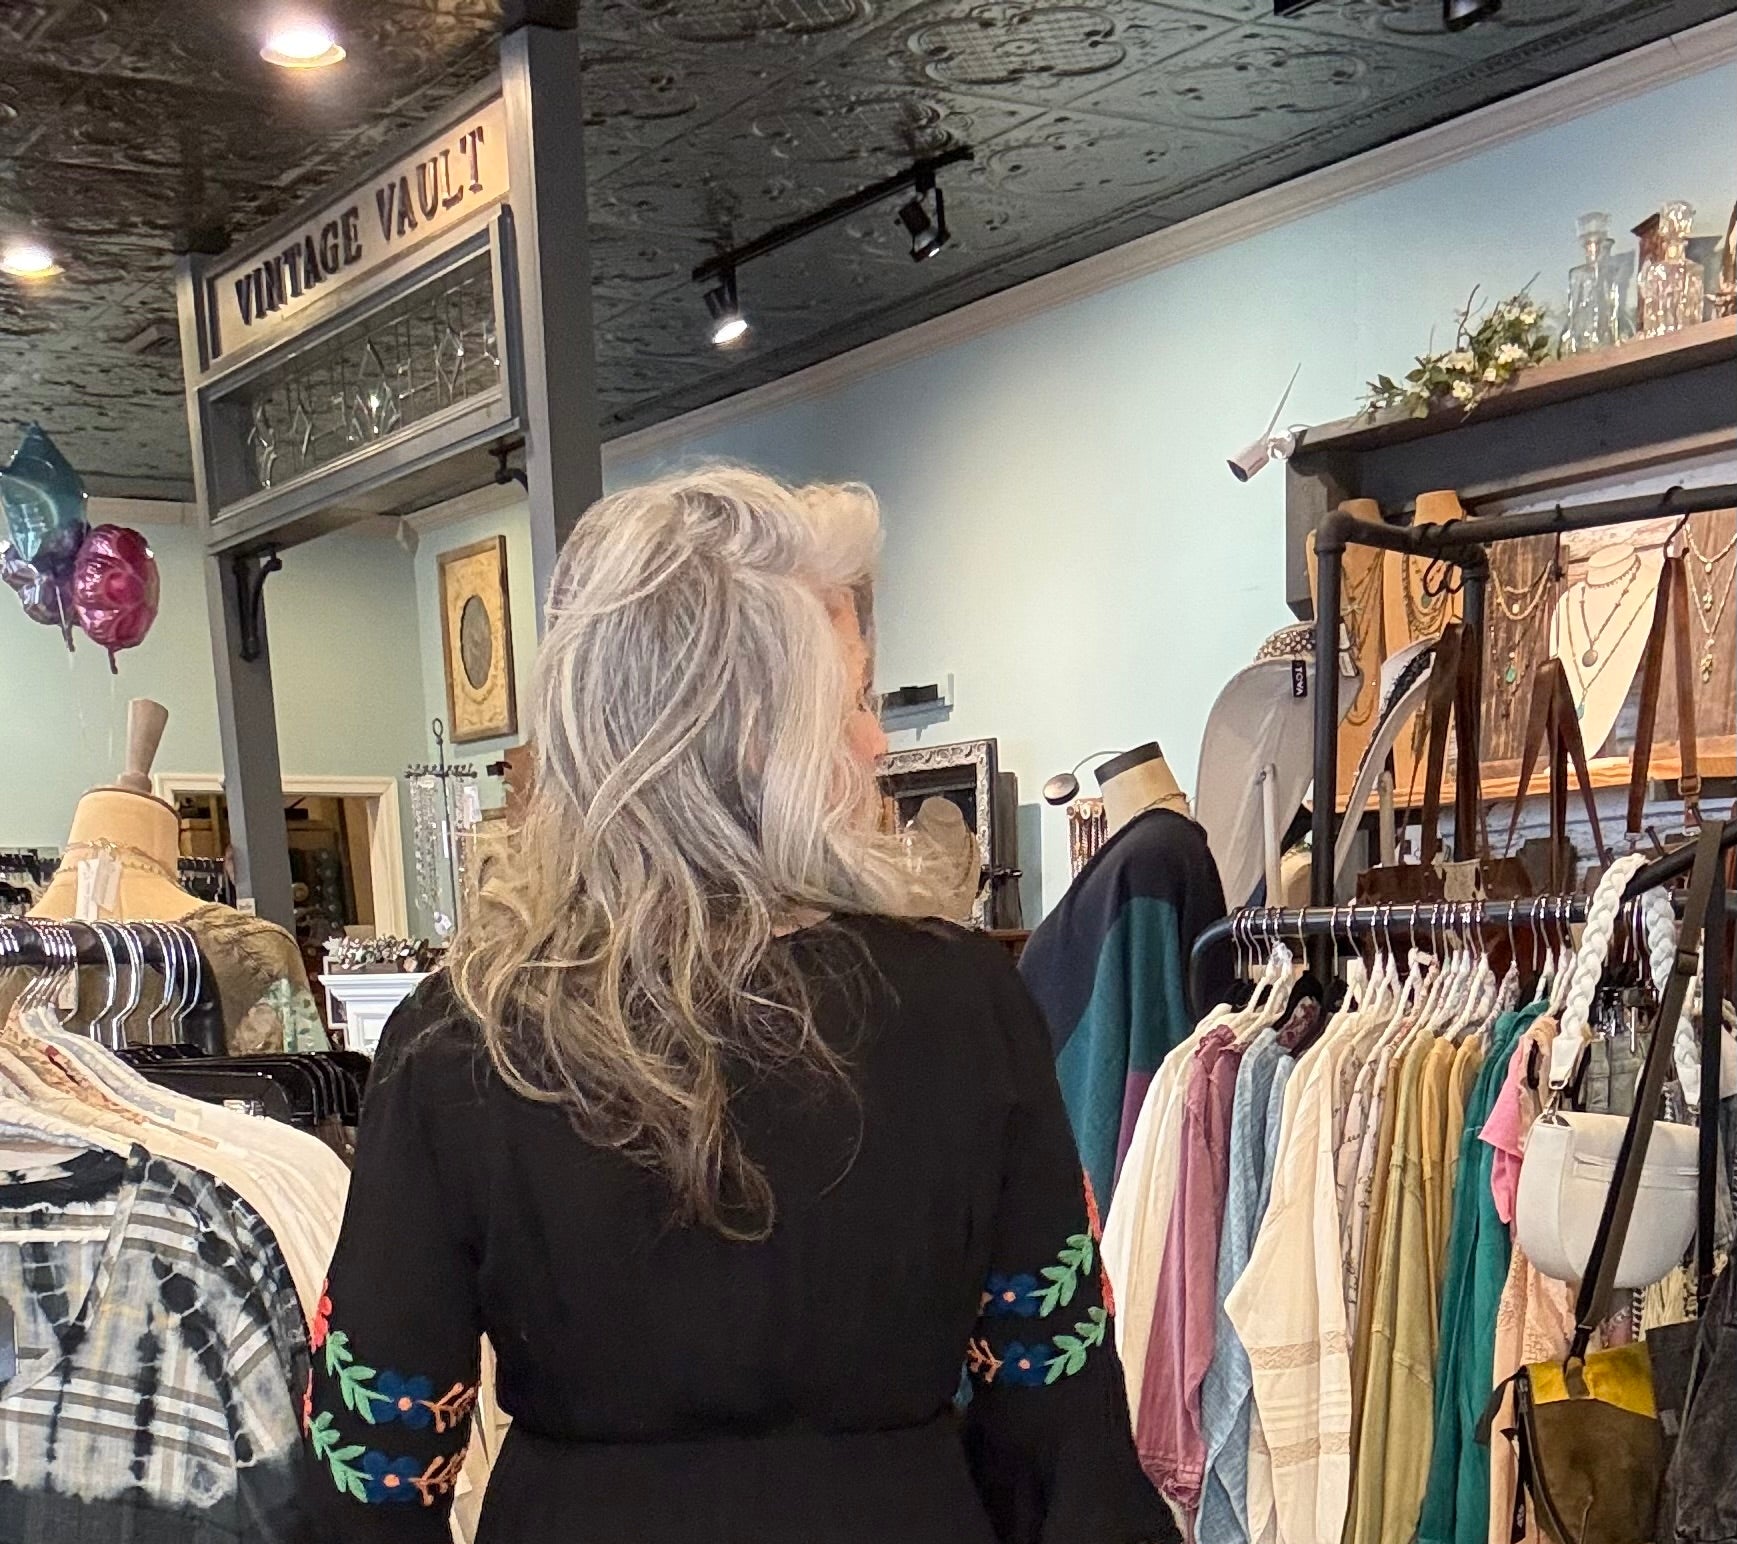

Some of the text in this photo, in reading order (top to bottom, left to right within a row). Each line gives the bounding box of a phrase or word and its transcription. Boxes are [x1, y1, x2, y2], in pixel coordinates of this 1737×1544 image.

[234, 126, 484, 326] VINTAGE VAULT
[1294, 666, 1304, 696] TOVA
